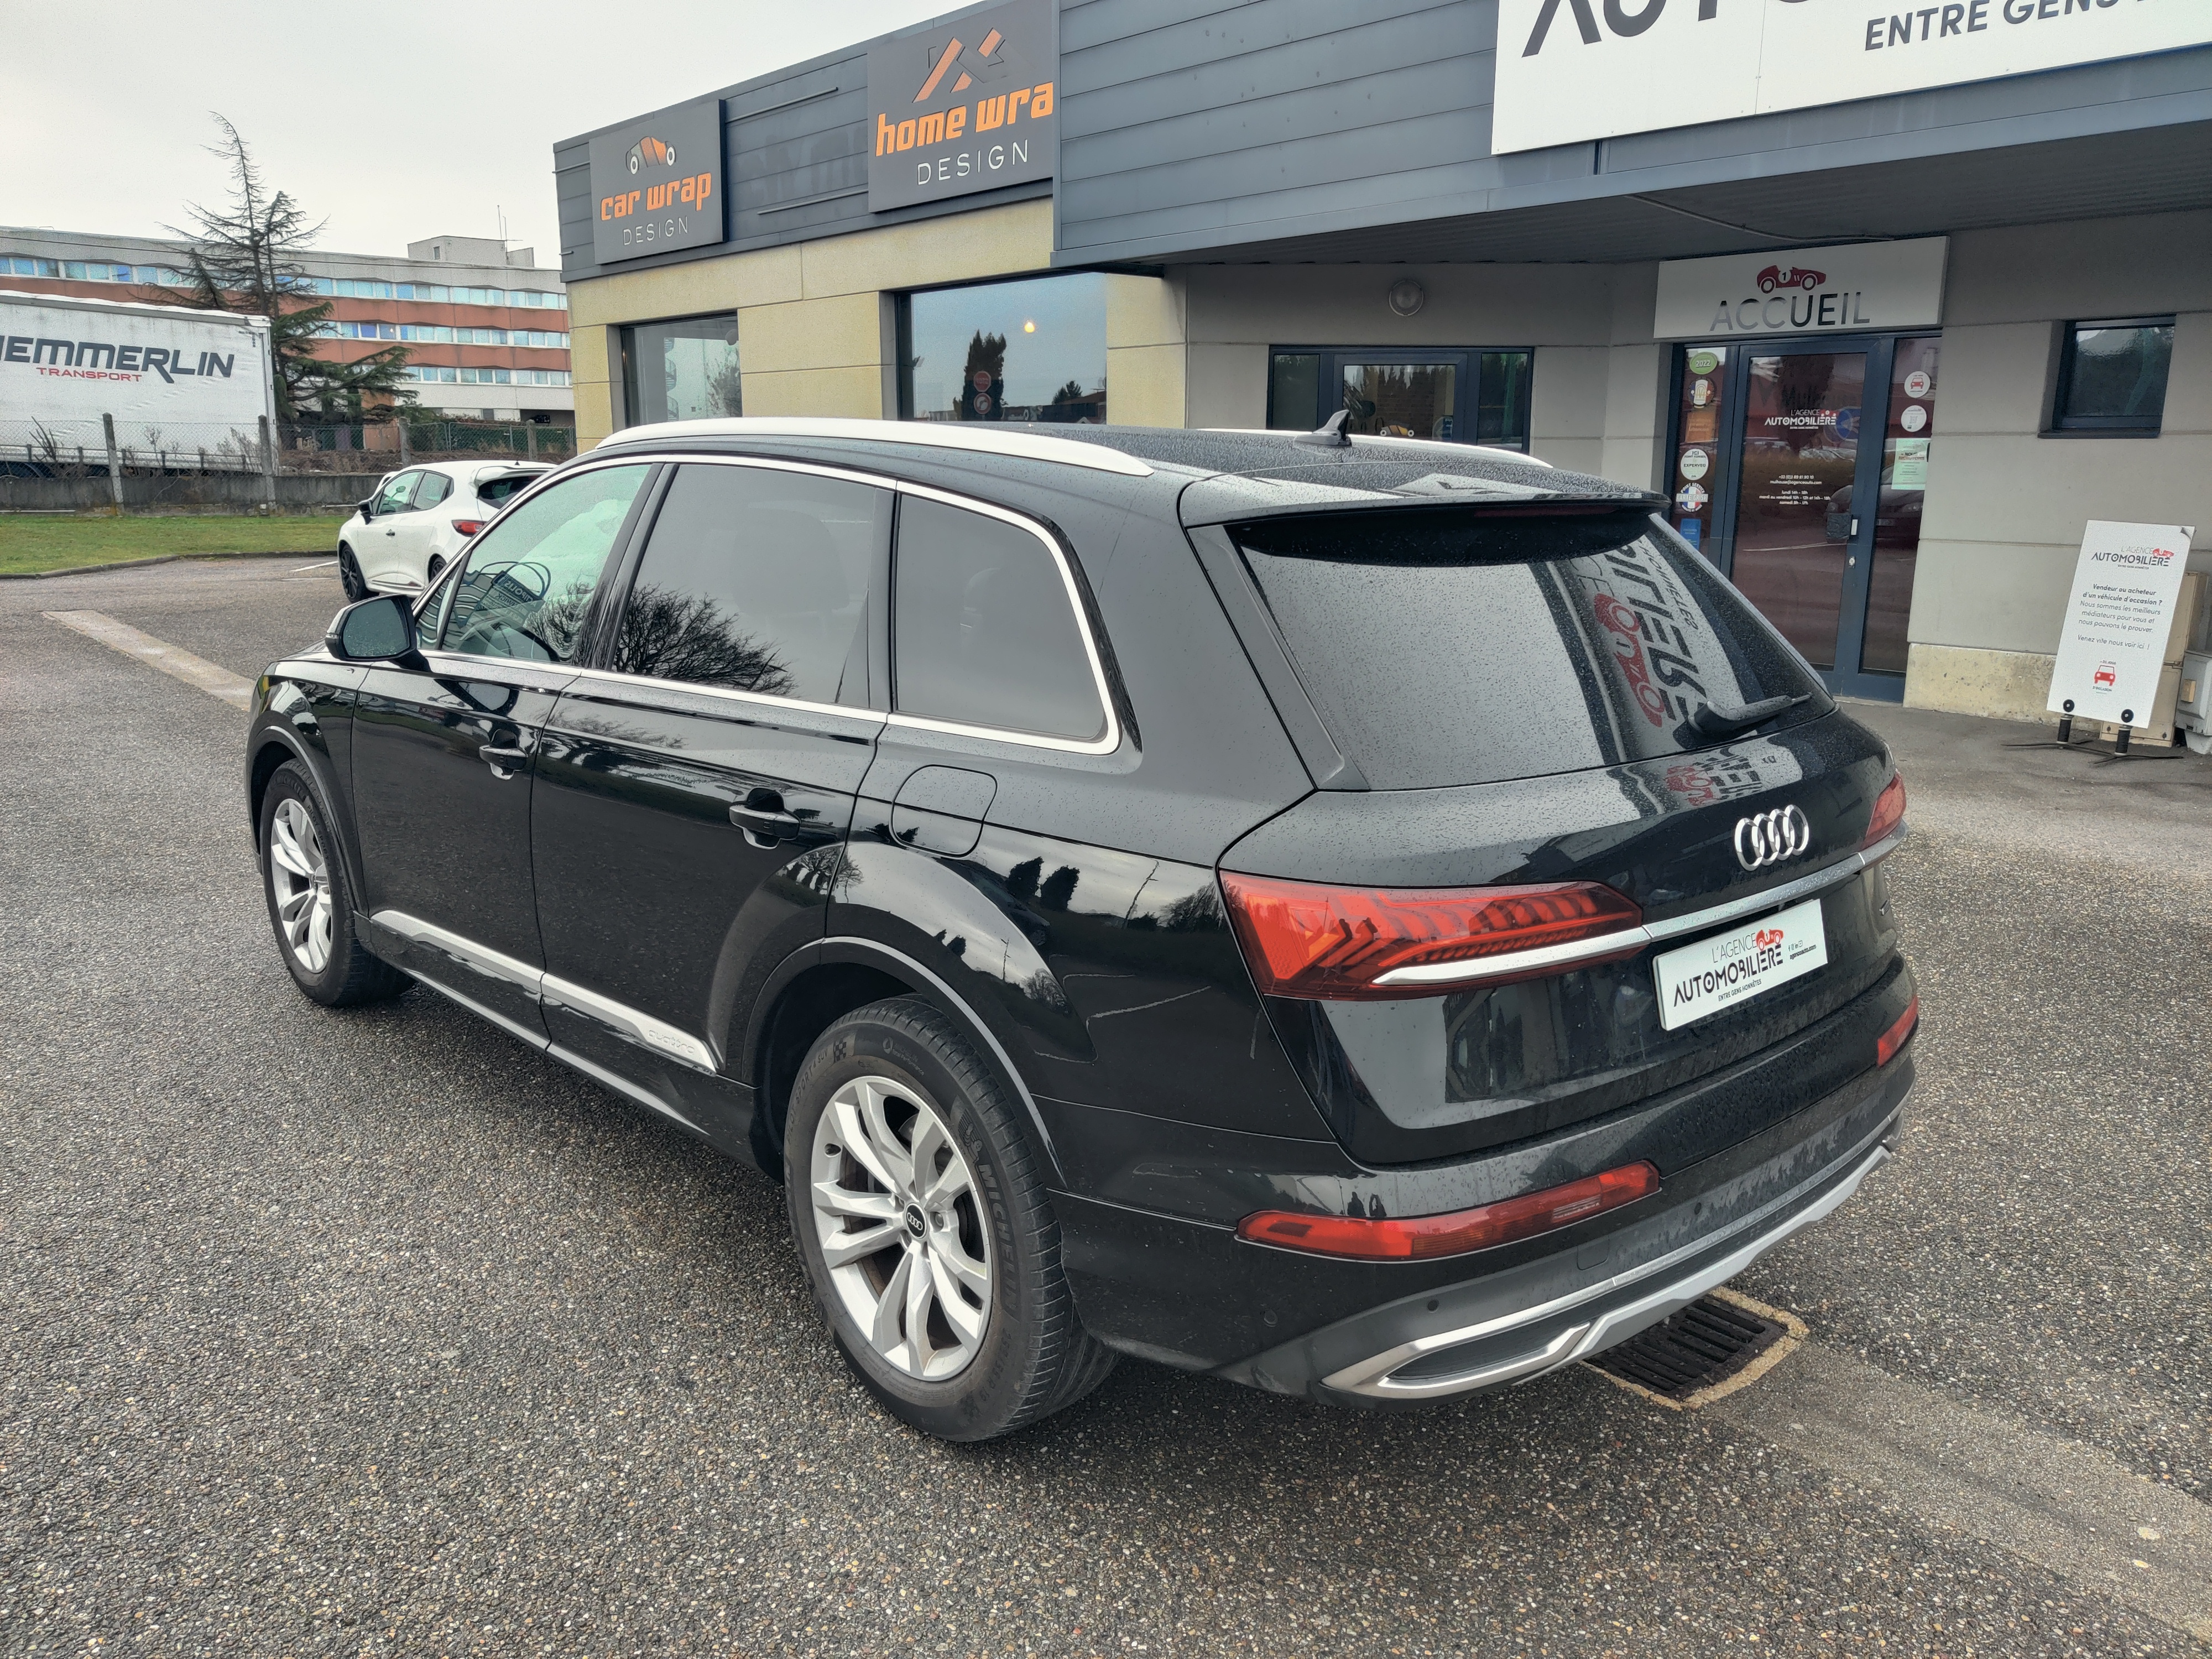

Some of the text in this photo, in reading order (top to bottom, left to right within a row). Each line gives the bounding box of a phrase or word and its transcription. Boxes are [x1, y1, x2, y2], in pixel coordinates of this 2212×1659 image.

[1865, 0, 1990, 51] ENTRE
[876, 105, 967, 156] home
[917, 139, 1029, 186] DESIGN
[601, 189, 640, 221] car
[646, 172, 712, 211] wrap
[623, 217, 689, 246] DESIGN
[1709, 291, 1871, 332] ACCUEIL
[36, 367, 143, 382] TRANSPORT
[1695, 359, 1711, 368] 2022
[2081, 611, 2116, 619] médiateurs
[2124, 596, 2157, 605] d'occasion
[2132, 607, 2161, 615] meilleurs
[2078, 634, 2095, 643] Venez
[1712, 932, 1757, 963] L'AGENCE
[1718, 978, 1762, 1001] ENTRE GENS HONNÊTES
[795, 1067, 815, 1104] SPORT
[817, 1049, 828, 1064] SUV
[978, 1164, 1017, 1314] MICHELIN
